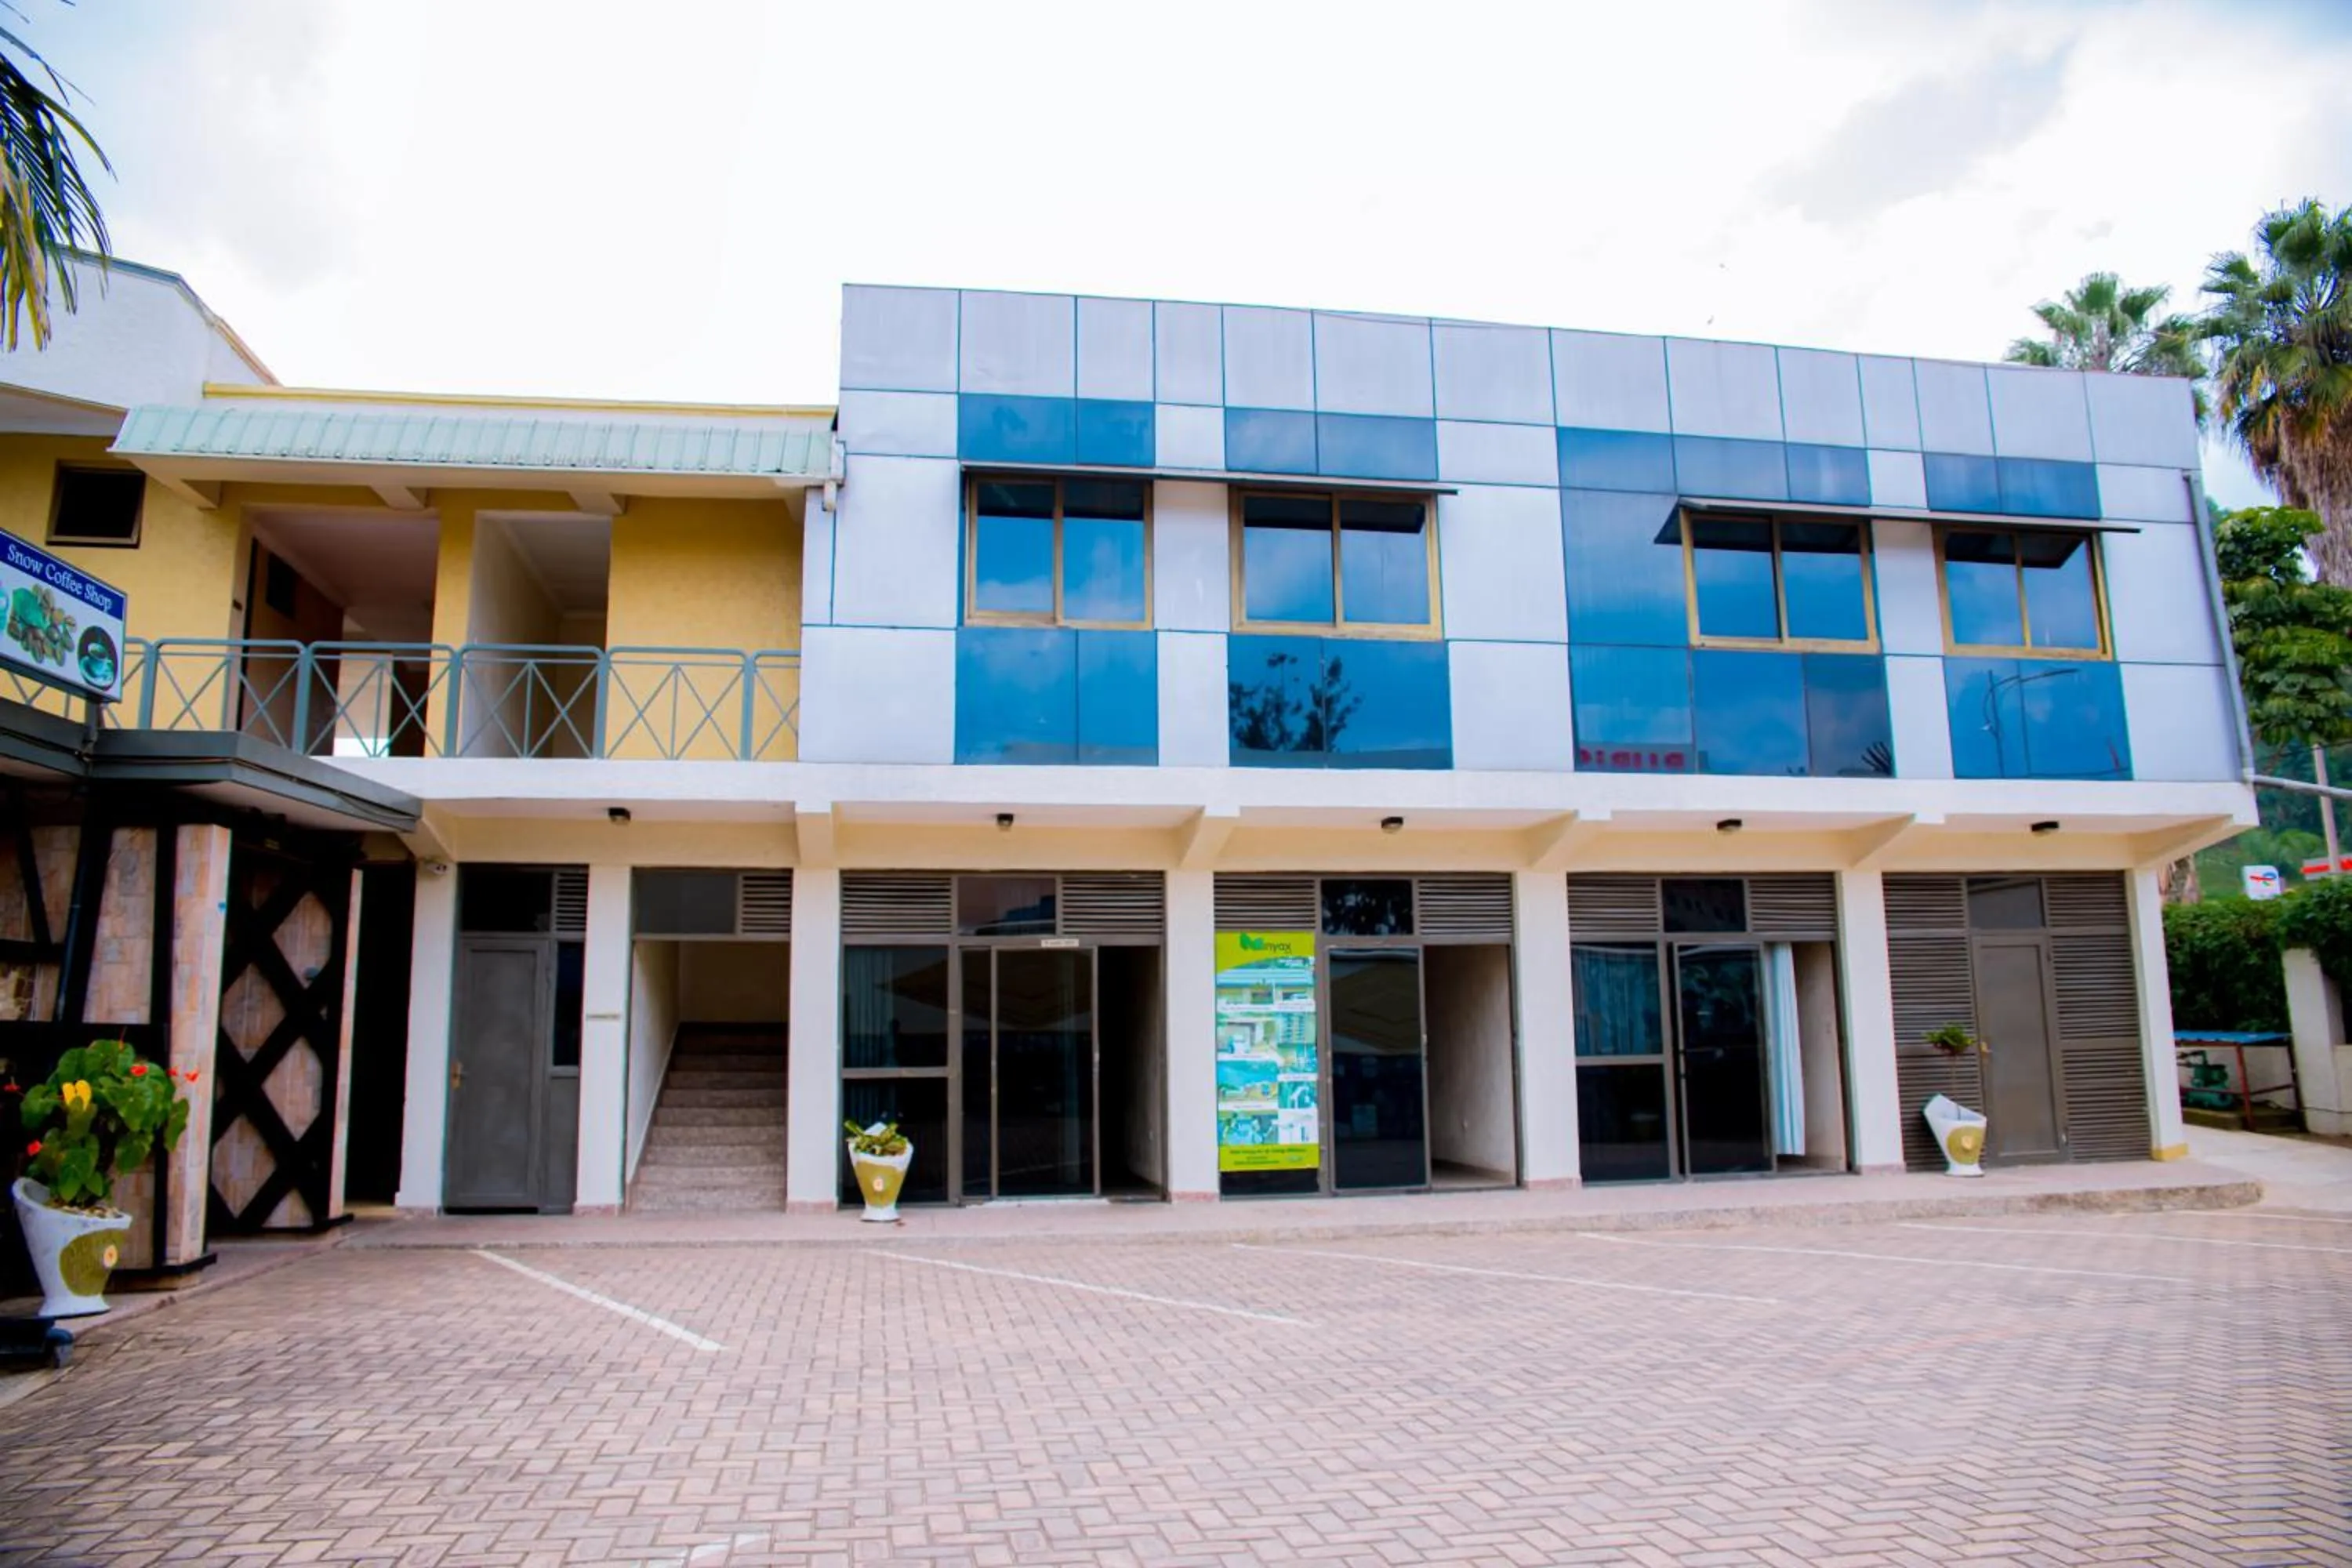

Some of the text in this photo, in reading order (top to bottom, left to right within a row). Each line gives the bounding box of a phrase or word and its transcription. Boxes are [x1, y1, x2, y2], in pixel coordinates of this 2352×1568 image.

[7, 543, 113, 613] Snow Coffee Shop
